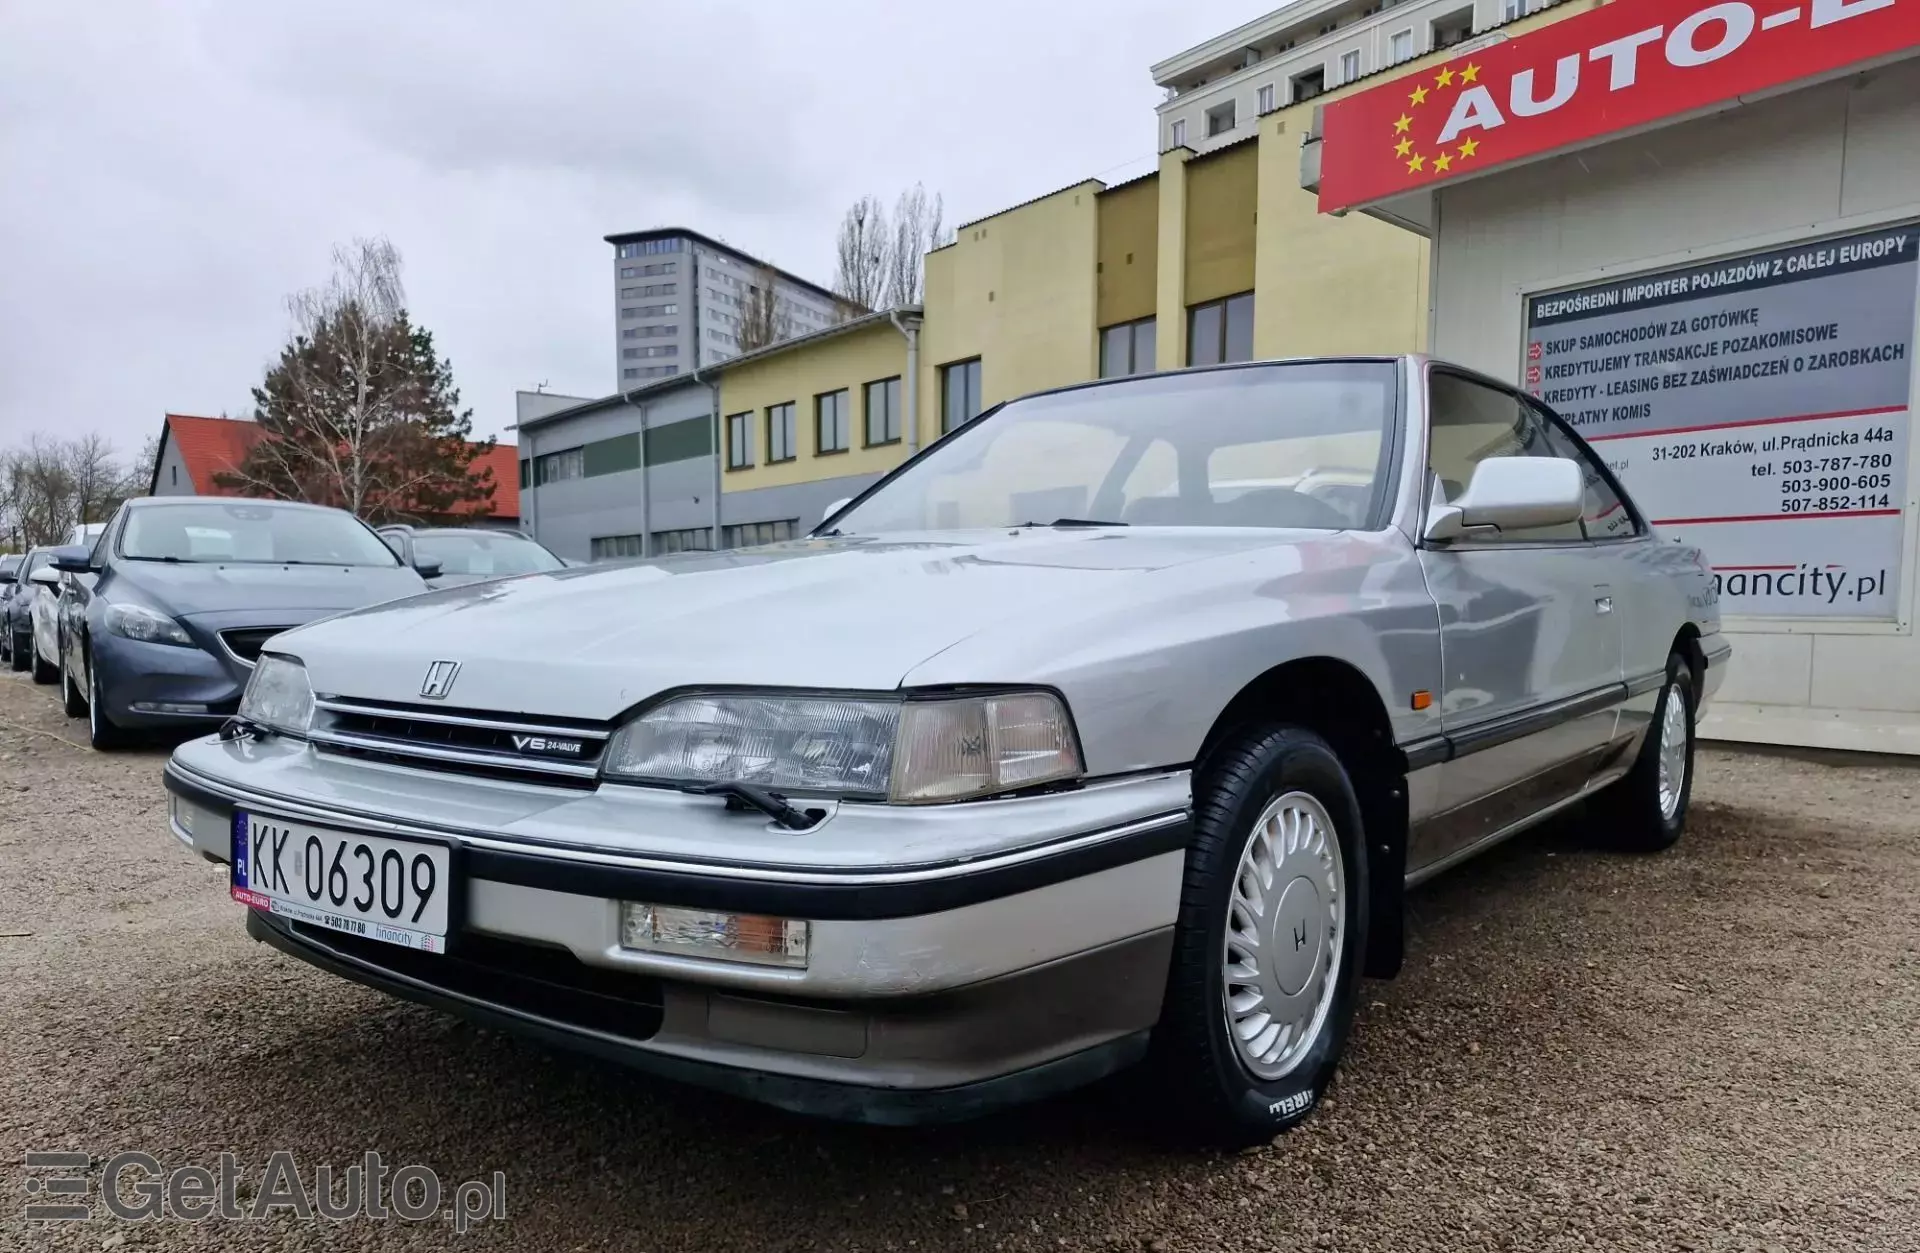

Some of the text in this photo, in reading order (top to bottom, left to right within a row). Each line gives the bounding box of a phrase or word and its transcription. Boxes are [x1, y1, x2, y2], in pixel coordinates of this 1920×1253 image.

[1537, 235, 1907, 319] BEZPOŚREDNI IMPORTER POJAZDÓW Z CAŁEJ EUROPY
[1546, 308, 1759, 355] SKUP SAMOCHODÓW ZA GOTÓWKĘ
[1545, 323, 1838, 380] KREDYTUJEMY TRANSAKCJE POZAKOMISOWE
[1544, 385, 1598, 404] KREDYTY
[1607, 378, 1659, 396] LEASING
[1663, 373, 1688, 389] BEZ
[1690, 354, 1789, 386] ZAŚWIADCZEŃ
[1793, 357, 1804, 373] O
[1808, 343, 1905, 371] ZAROBKACH
[1561, 403, 1651, 426] PŁATNY KOMIS
[1652, 427, 1894, 461] 31-202 Kraków, ul.Prądnicka 44a
[1752, 453, 1892, 476] tel. 503-787-780
[1782, 473, 1891, 493] 503-900-605
[1782, 493, 1889, 512] 507-852-114
[512, 735, 581, 753] V6 24-VALVE
[237, 858, 247, 877] PL
[253, 822, 436, 923] KK 06309
[331, 917, 341, 929] 503
[351, 921, 357, 933] 77
[357, 922, 366, 934] 80
[375, 922, 412, 947] financity
